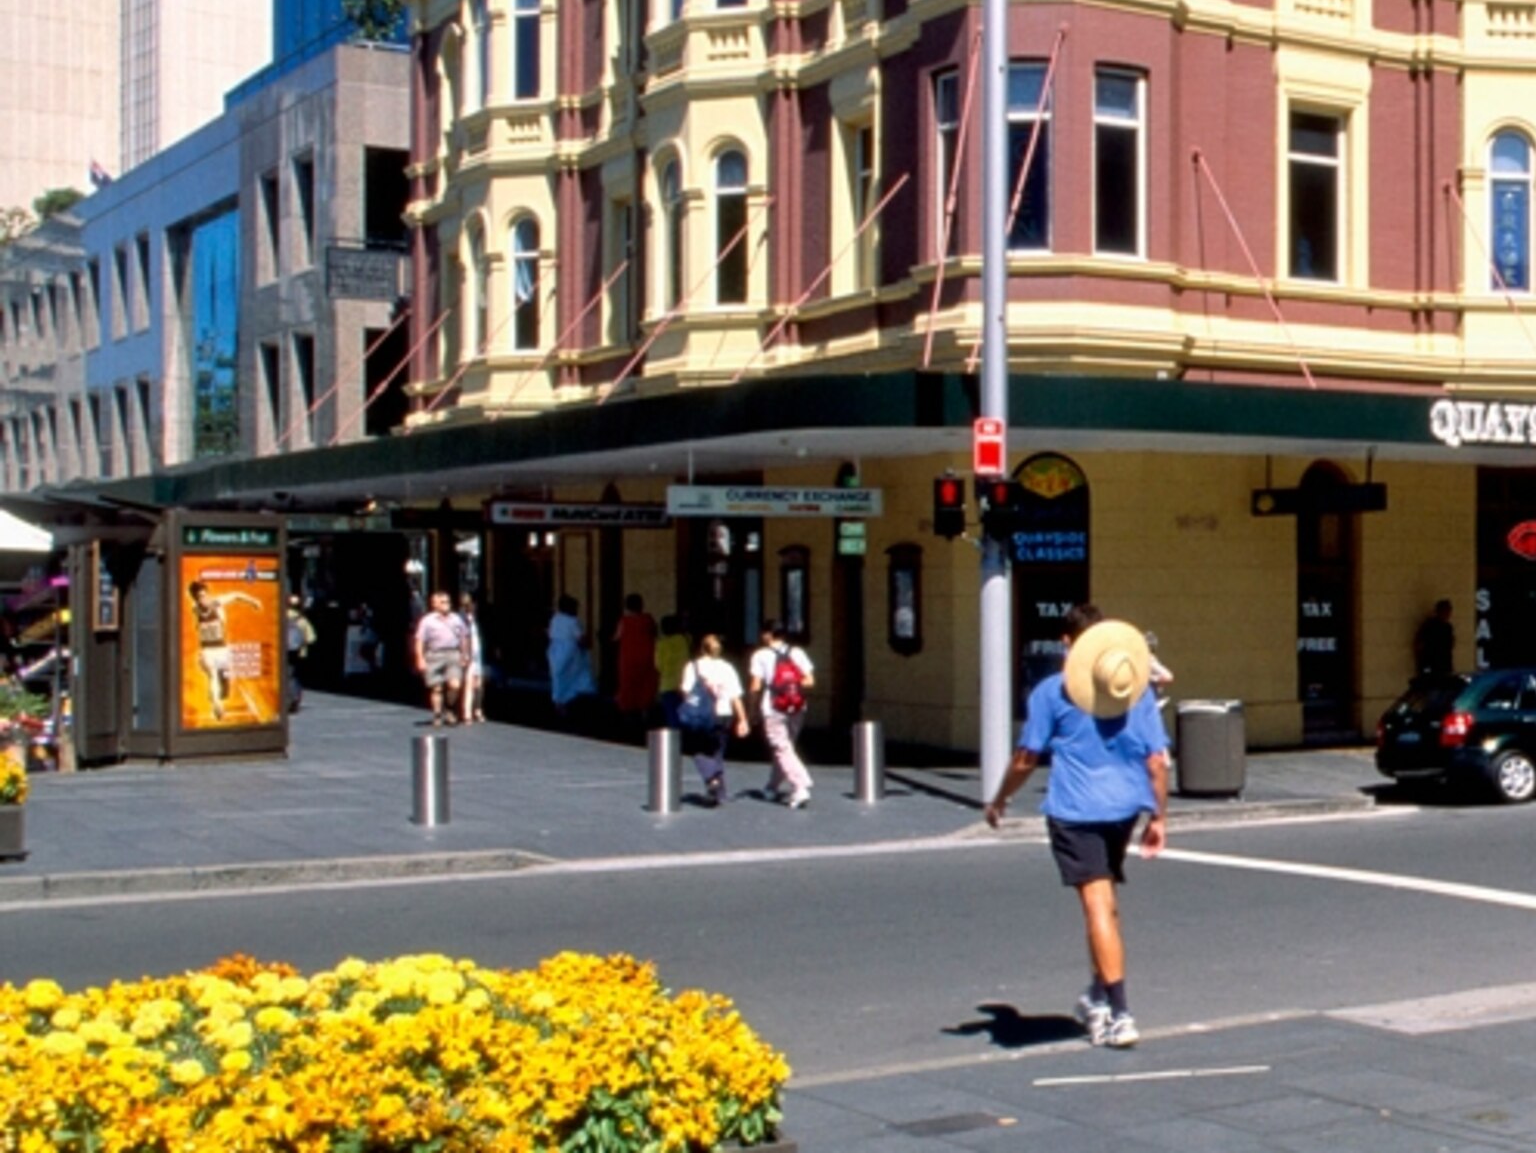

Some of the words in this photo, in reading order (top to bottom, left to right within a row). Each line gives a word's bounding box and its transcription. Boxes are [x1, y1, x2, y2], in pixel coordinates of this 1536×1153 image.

[726, 488, 799, 502] CURRENCY
[803, 490, 872, 503] EXCHANGE
[1012, 531, 1087, 545] QUAYSIDE
[1016, 547, 1085, 561] CLASSICS
[1036, 602, 1073, 617] TAX
[1302, 602, 1333, 617] TAX
[1476, 588, 1491, 669] SAL
[1298, 638, 1336, 651] FREE
